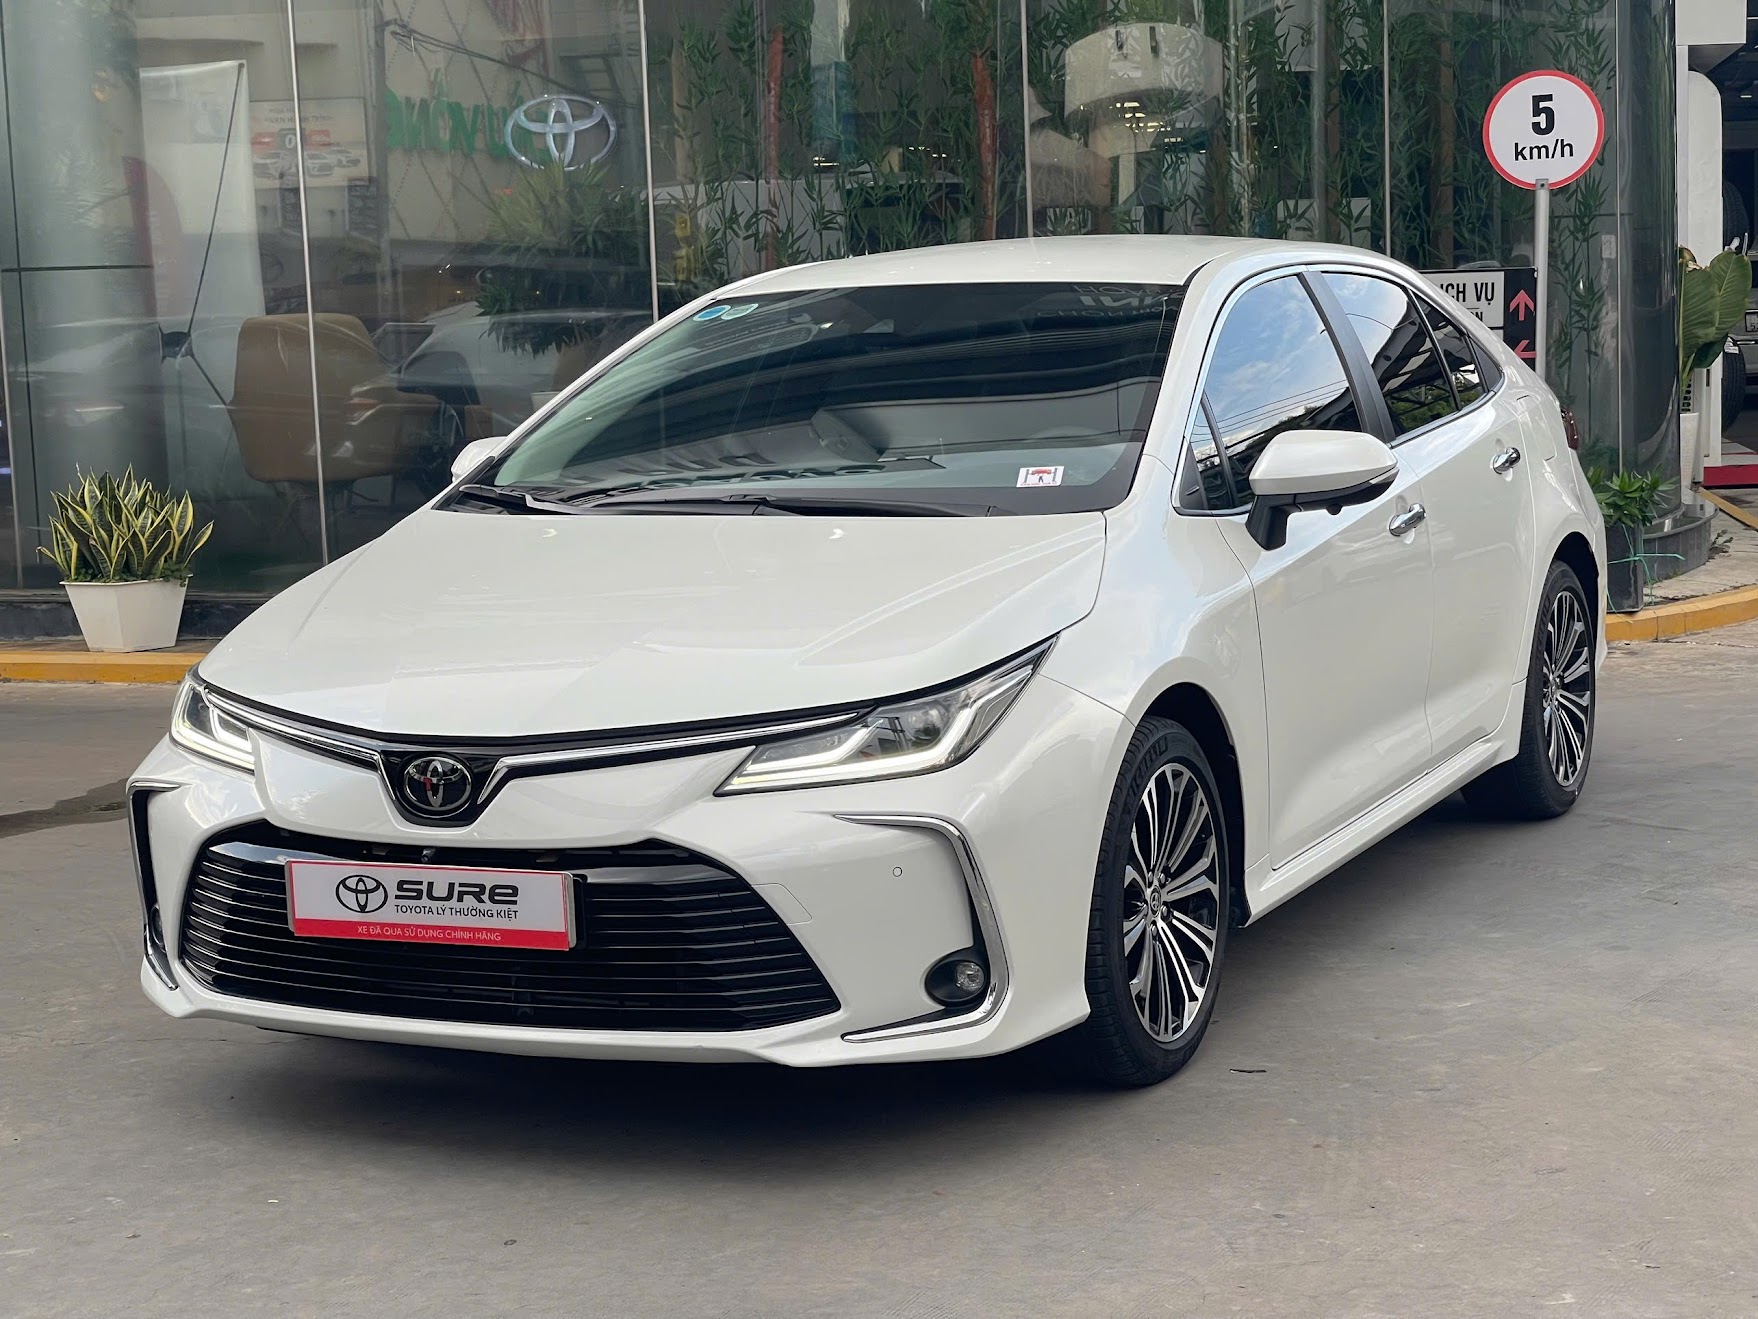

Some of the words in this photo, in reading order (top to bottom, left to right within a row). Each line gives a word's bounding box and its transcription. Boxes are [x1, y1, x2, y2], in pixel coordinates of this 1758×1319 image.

[1531, 94, 1555, 136] 5
[1514, 139, 1574, 161] km/h
[1440, 282, 1467, 303] CH
[1474, 281, 1495, 306] VỤ
[394, 904, 435, 916] TOYOTA
[436, 904, 448, 916] LÝ
[448, 904, 494, 919] THƯỜNG
[496, 907, 519, 922] KIỆT
[357, 925, 368, 935] XE
[383, 927, 403, 937] QUA
[417, 928, 444, 940] DỤNG
[445, 928, 473, 940] CHÍNH
